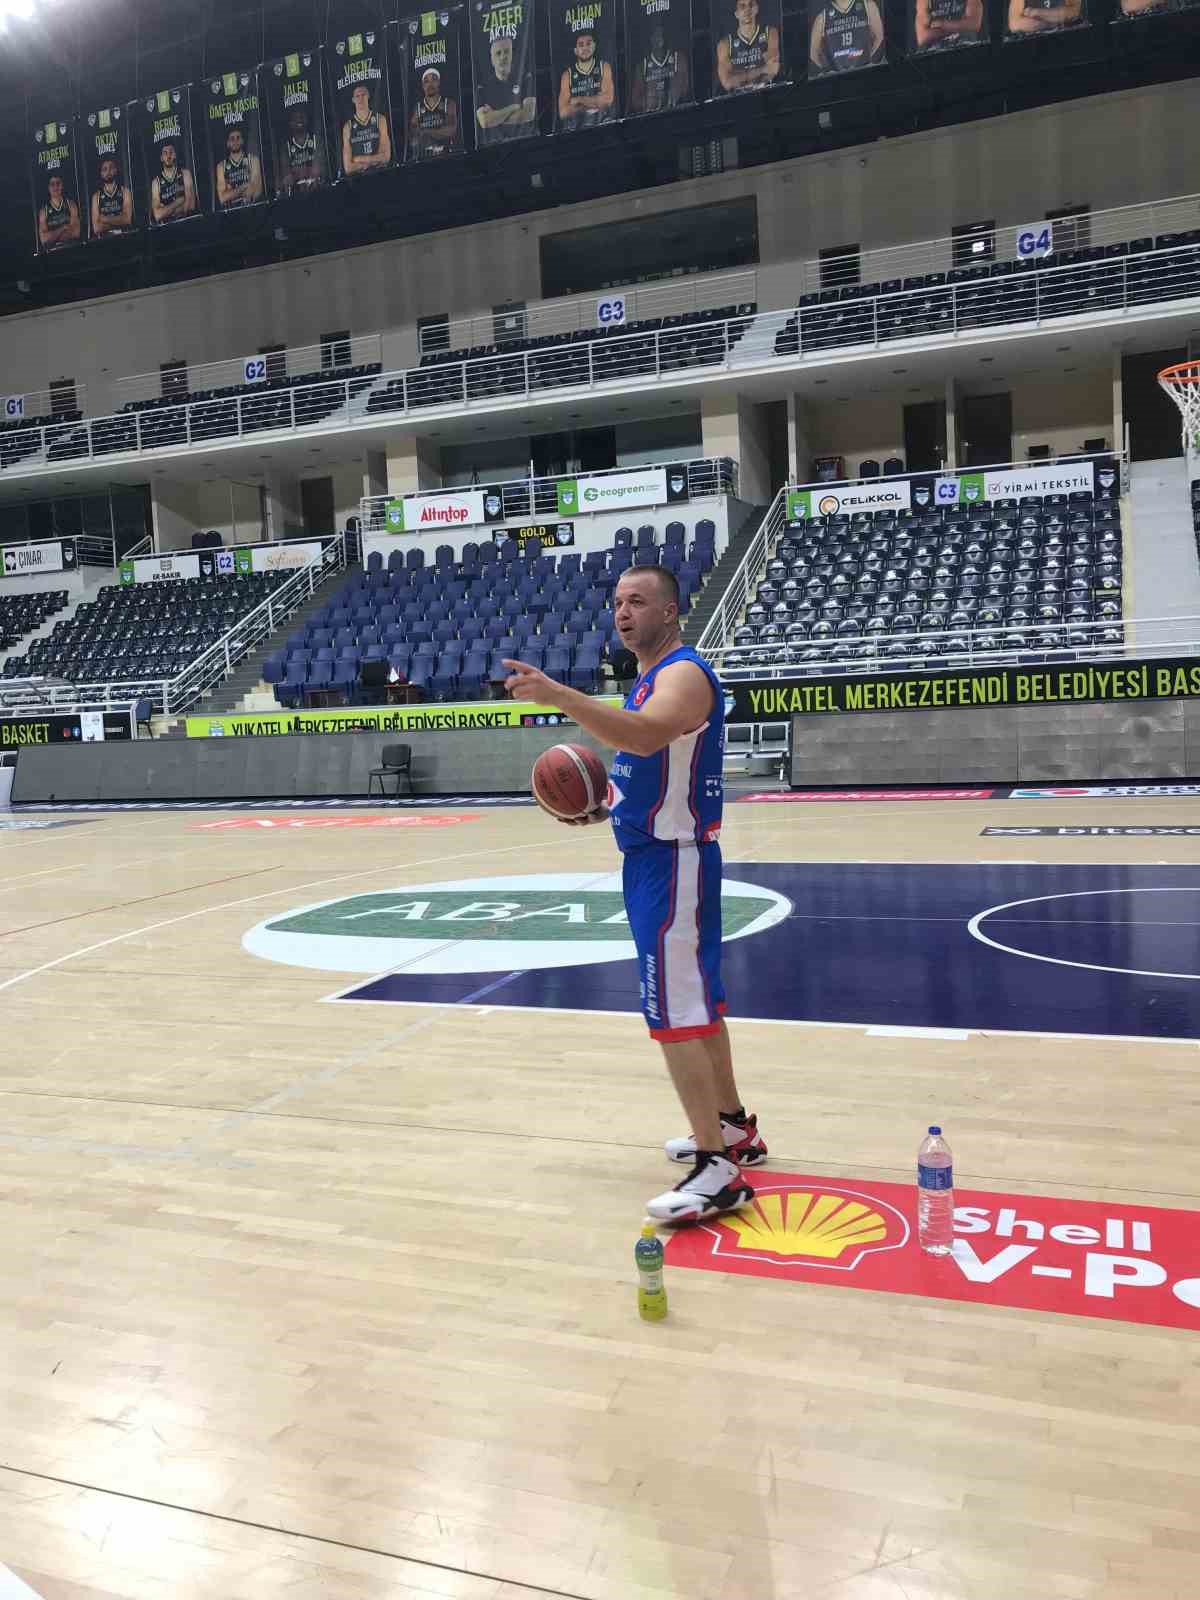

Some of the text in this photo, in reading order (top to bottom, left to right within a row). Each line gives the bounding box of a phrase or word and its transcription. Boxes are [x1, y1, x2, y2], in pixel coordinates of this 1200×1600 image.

[482, 5, 522, 32] ZAFER
[489, 24, 517, 43] AKTAŞ
[841, 31, 853, 47] 19
[416, 40, 446, 57] JUSTIN
[414, 52, 446, 69] ROBINSON
[283, 80, 308, 98] JALEN
[1018, 228, 1050, 254] G4
[599, 300, 624, 322] G3
[245, 360, 265, 380] G2
[6, 399, 23, 415] G1
[600, 485, 645, 498] ecogreen
[938, 483, 957, 499] C3
[1042, 477, 1089, 490] TEKSTİL
[519, 526, 546, 538] GOLD
[219, 555, 232, 569] C2
[750, 684, 839, 714] YUKATEL
[845, 671, 1008, 709] MERKEZEFENDİ
[1016, 665, 1148, 701] BELEDİYESİ
[2, 723, 49, 744] BASKET
